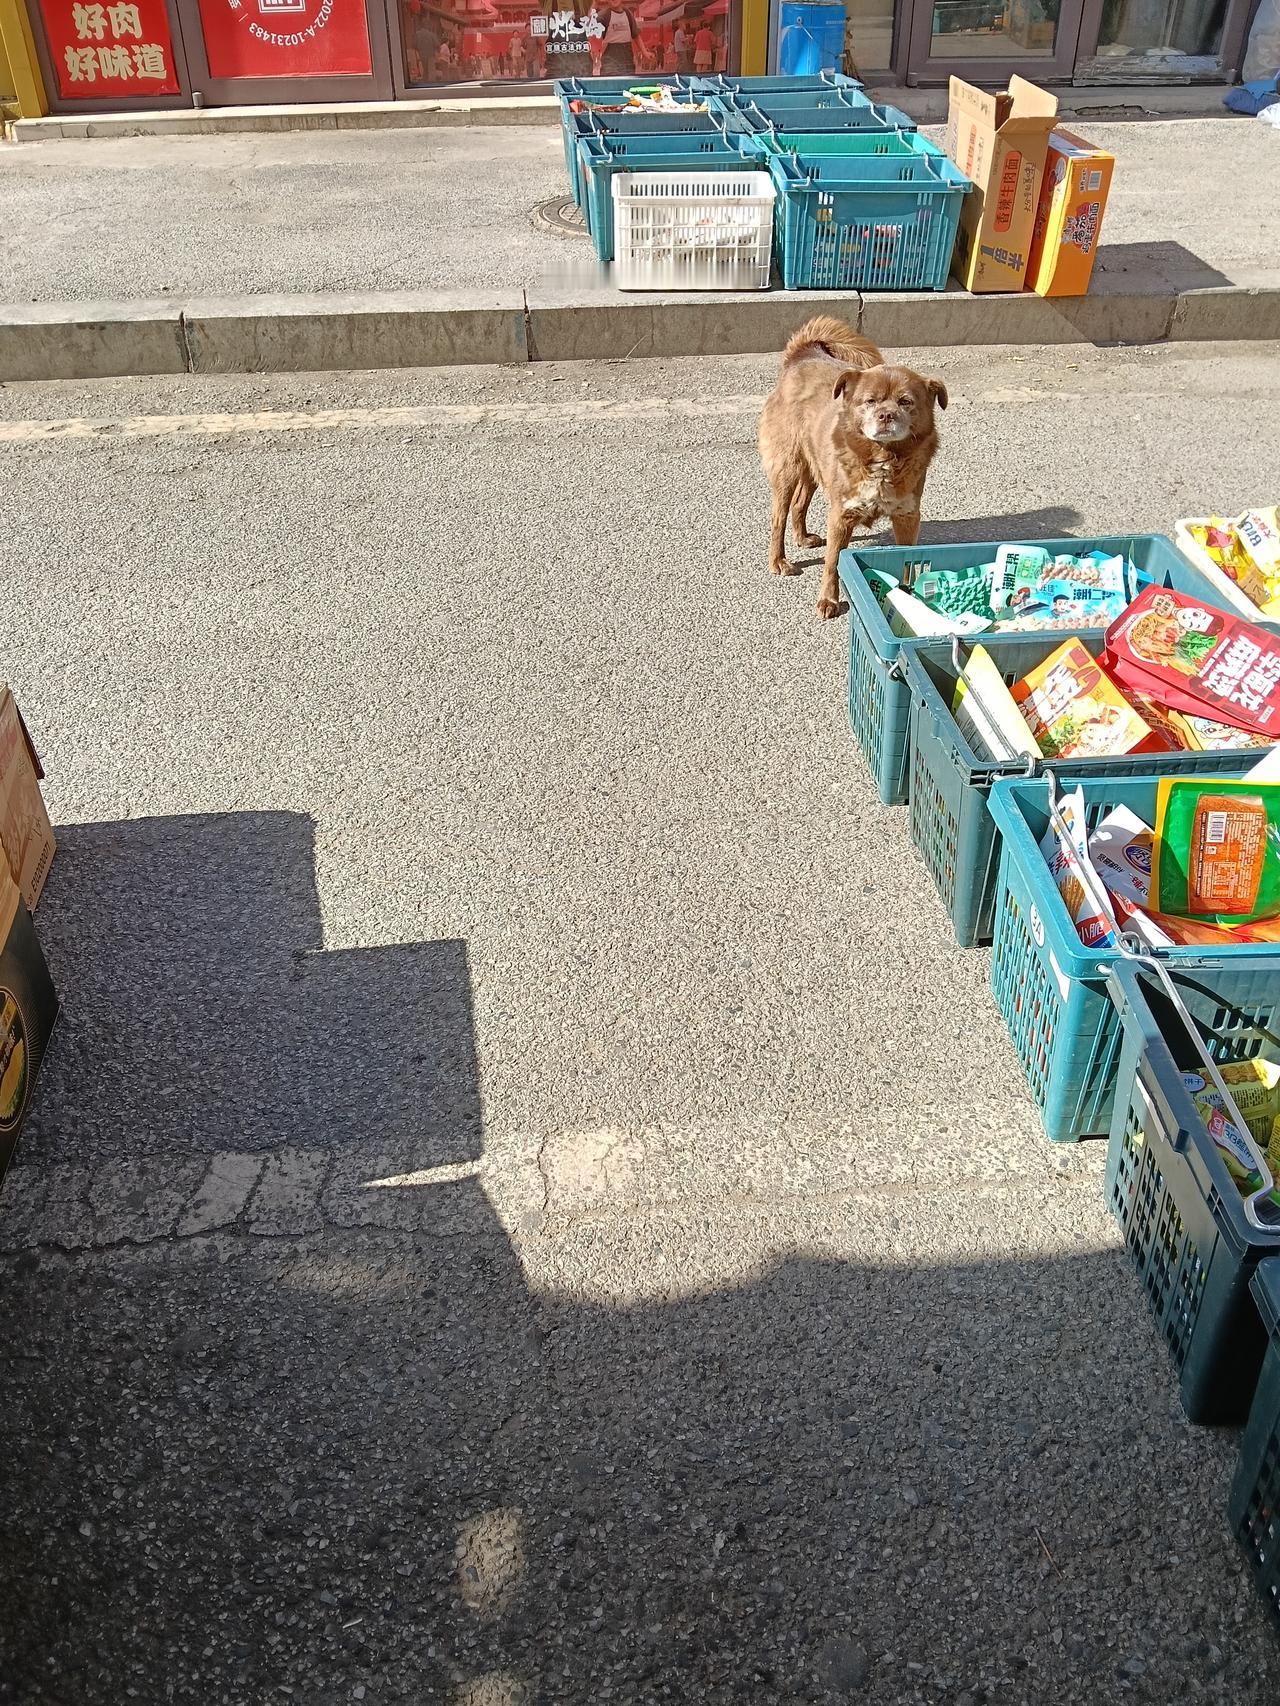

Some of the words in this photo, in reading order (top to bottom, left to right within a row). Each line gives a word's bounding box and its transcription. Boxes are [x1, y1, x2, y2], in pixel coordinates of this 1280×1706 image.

[73, 2, 144, 40] 好肉
[64, 45, 167, 82] 好味道
[997, 157, 1021, 225] 香辣牛肉面
[1202, 634, 1262, 698] 麻辣烫
